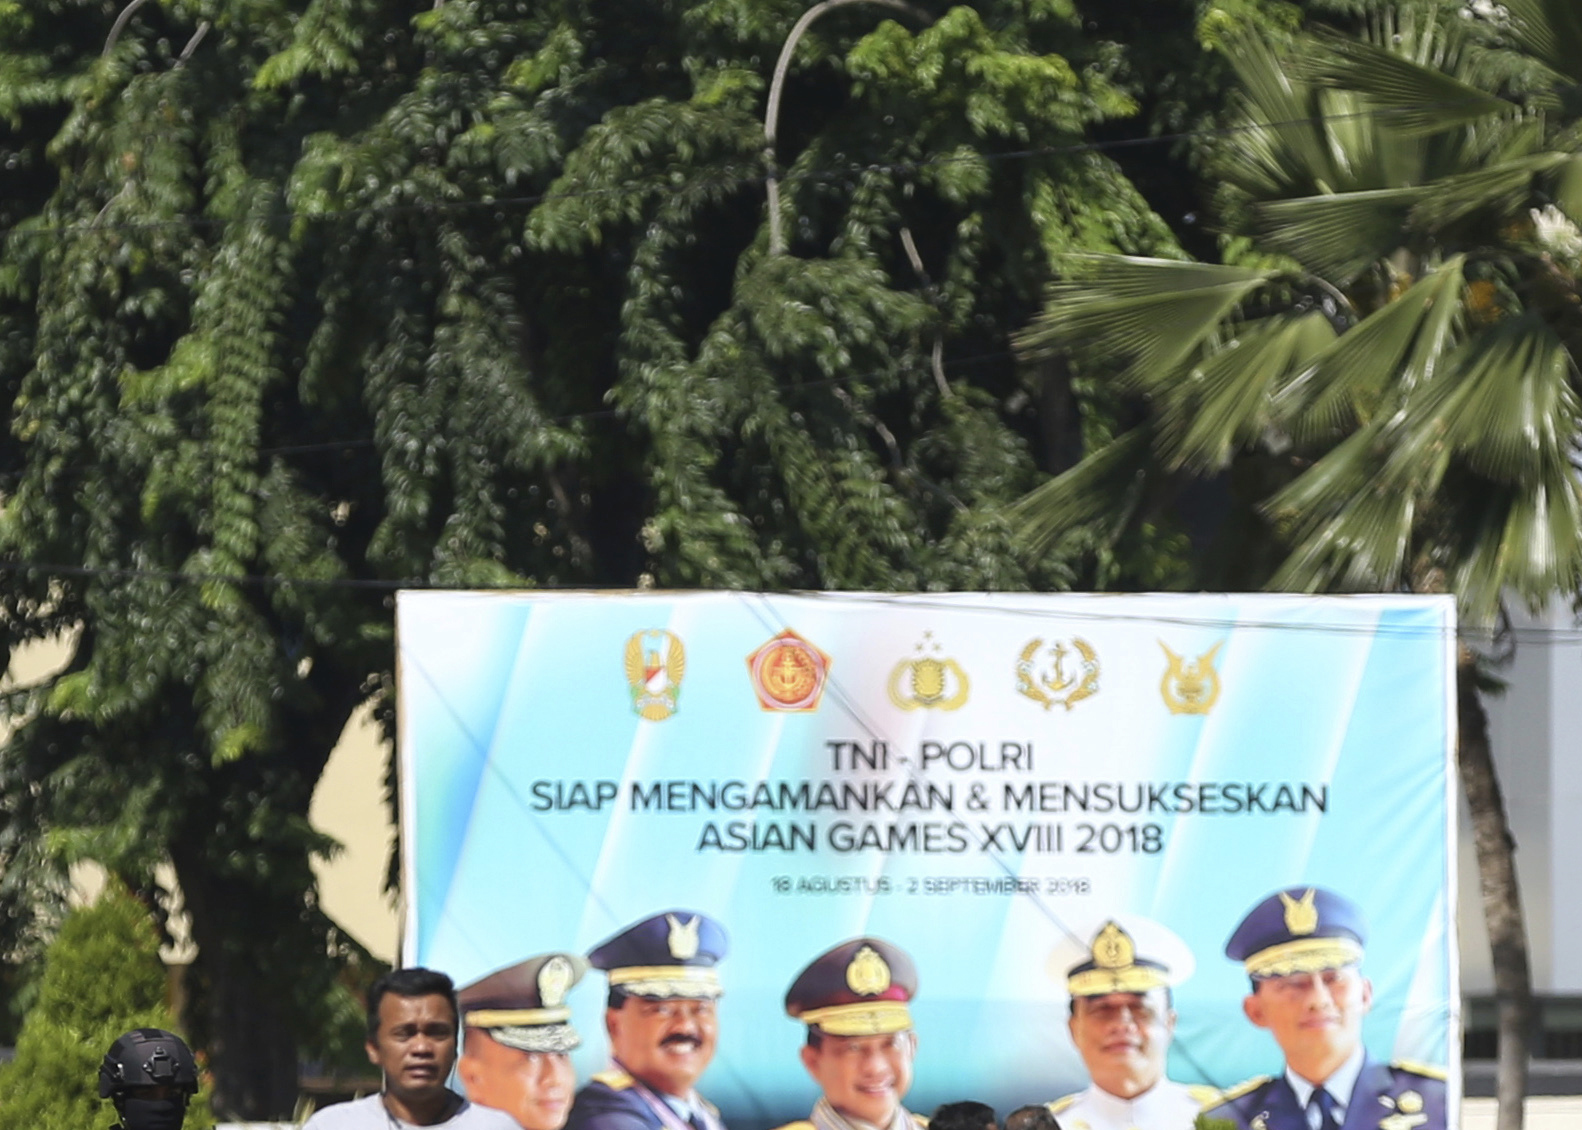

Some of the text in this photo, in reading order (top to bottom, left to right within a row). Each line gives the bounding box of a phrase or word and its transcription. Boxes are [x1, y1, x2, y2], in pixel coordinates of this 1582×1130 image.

[827, 741, 888, 770] TNI
[921, 741, 1033, 771] POLRI
[532, 780, 1328, 813] SIAP MENGAMANKAN & MENSUKSESKAN
[697, 821, 1164, 853] ASIAN GAMES XVIII 2018
[796, 876, 891, 894] AGUSTUS
[923, 877, 1040, 894] SEPTEMBER
